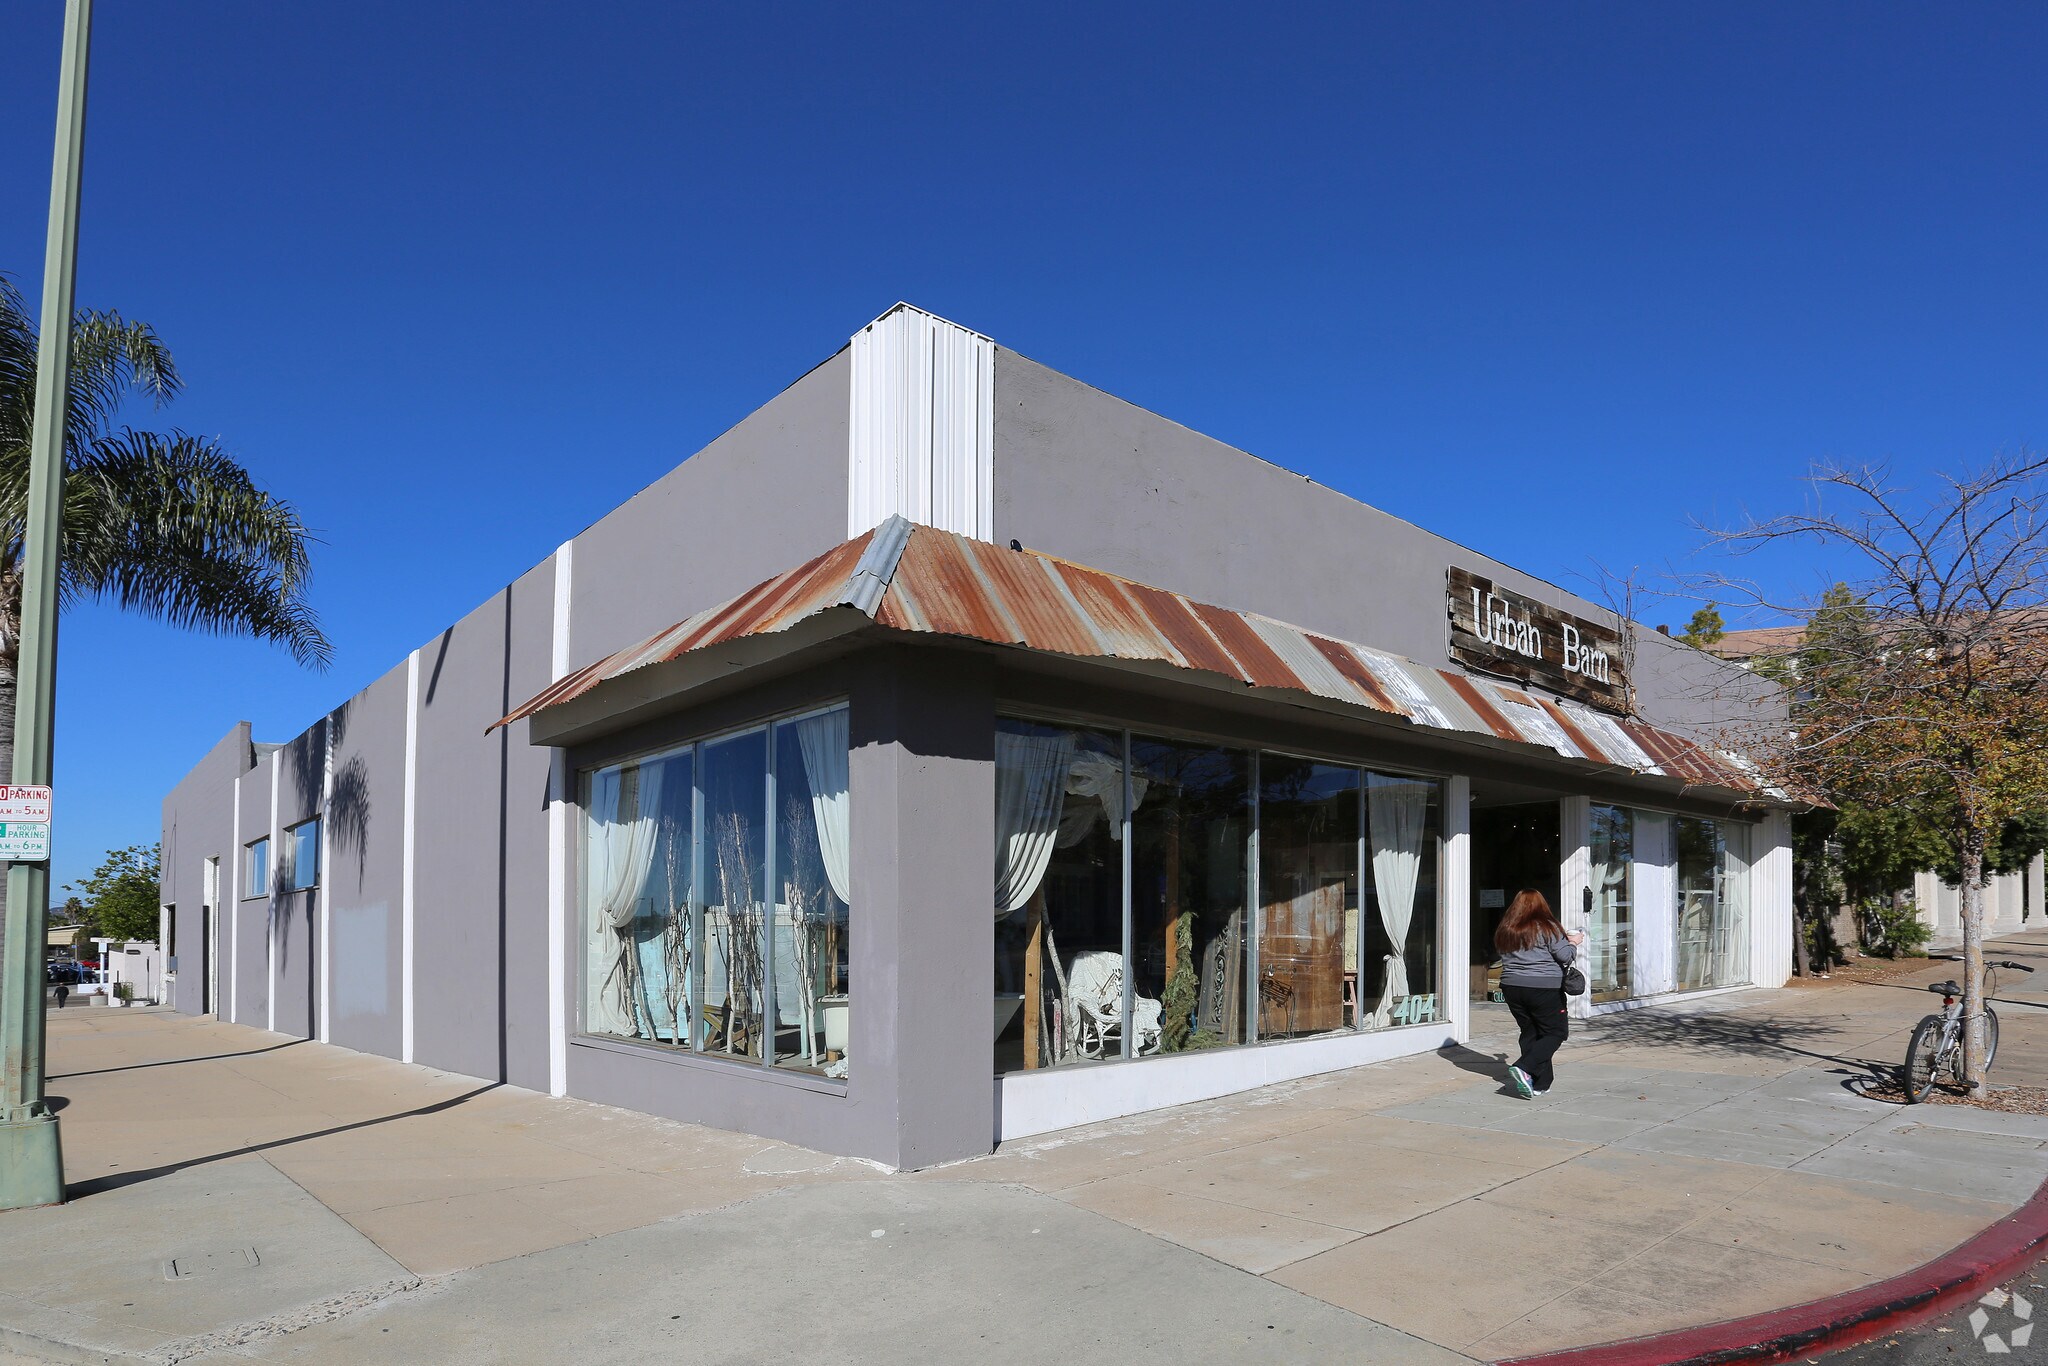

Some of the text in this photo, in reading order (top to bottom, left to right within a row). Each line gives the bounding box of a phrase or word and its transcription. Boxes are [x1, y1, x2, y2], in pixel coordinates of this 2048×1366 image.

[1471, 587, 1610, 685] Urban Barn
[0, 788, 48, 800] O PARKING
[24, 806, 31, 815] 5
[8, 831, 45, 839] PARKING
[23, 841, 29, 850] 6
[1394, 993, 1435, 1026] 404
